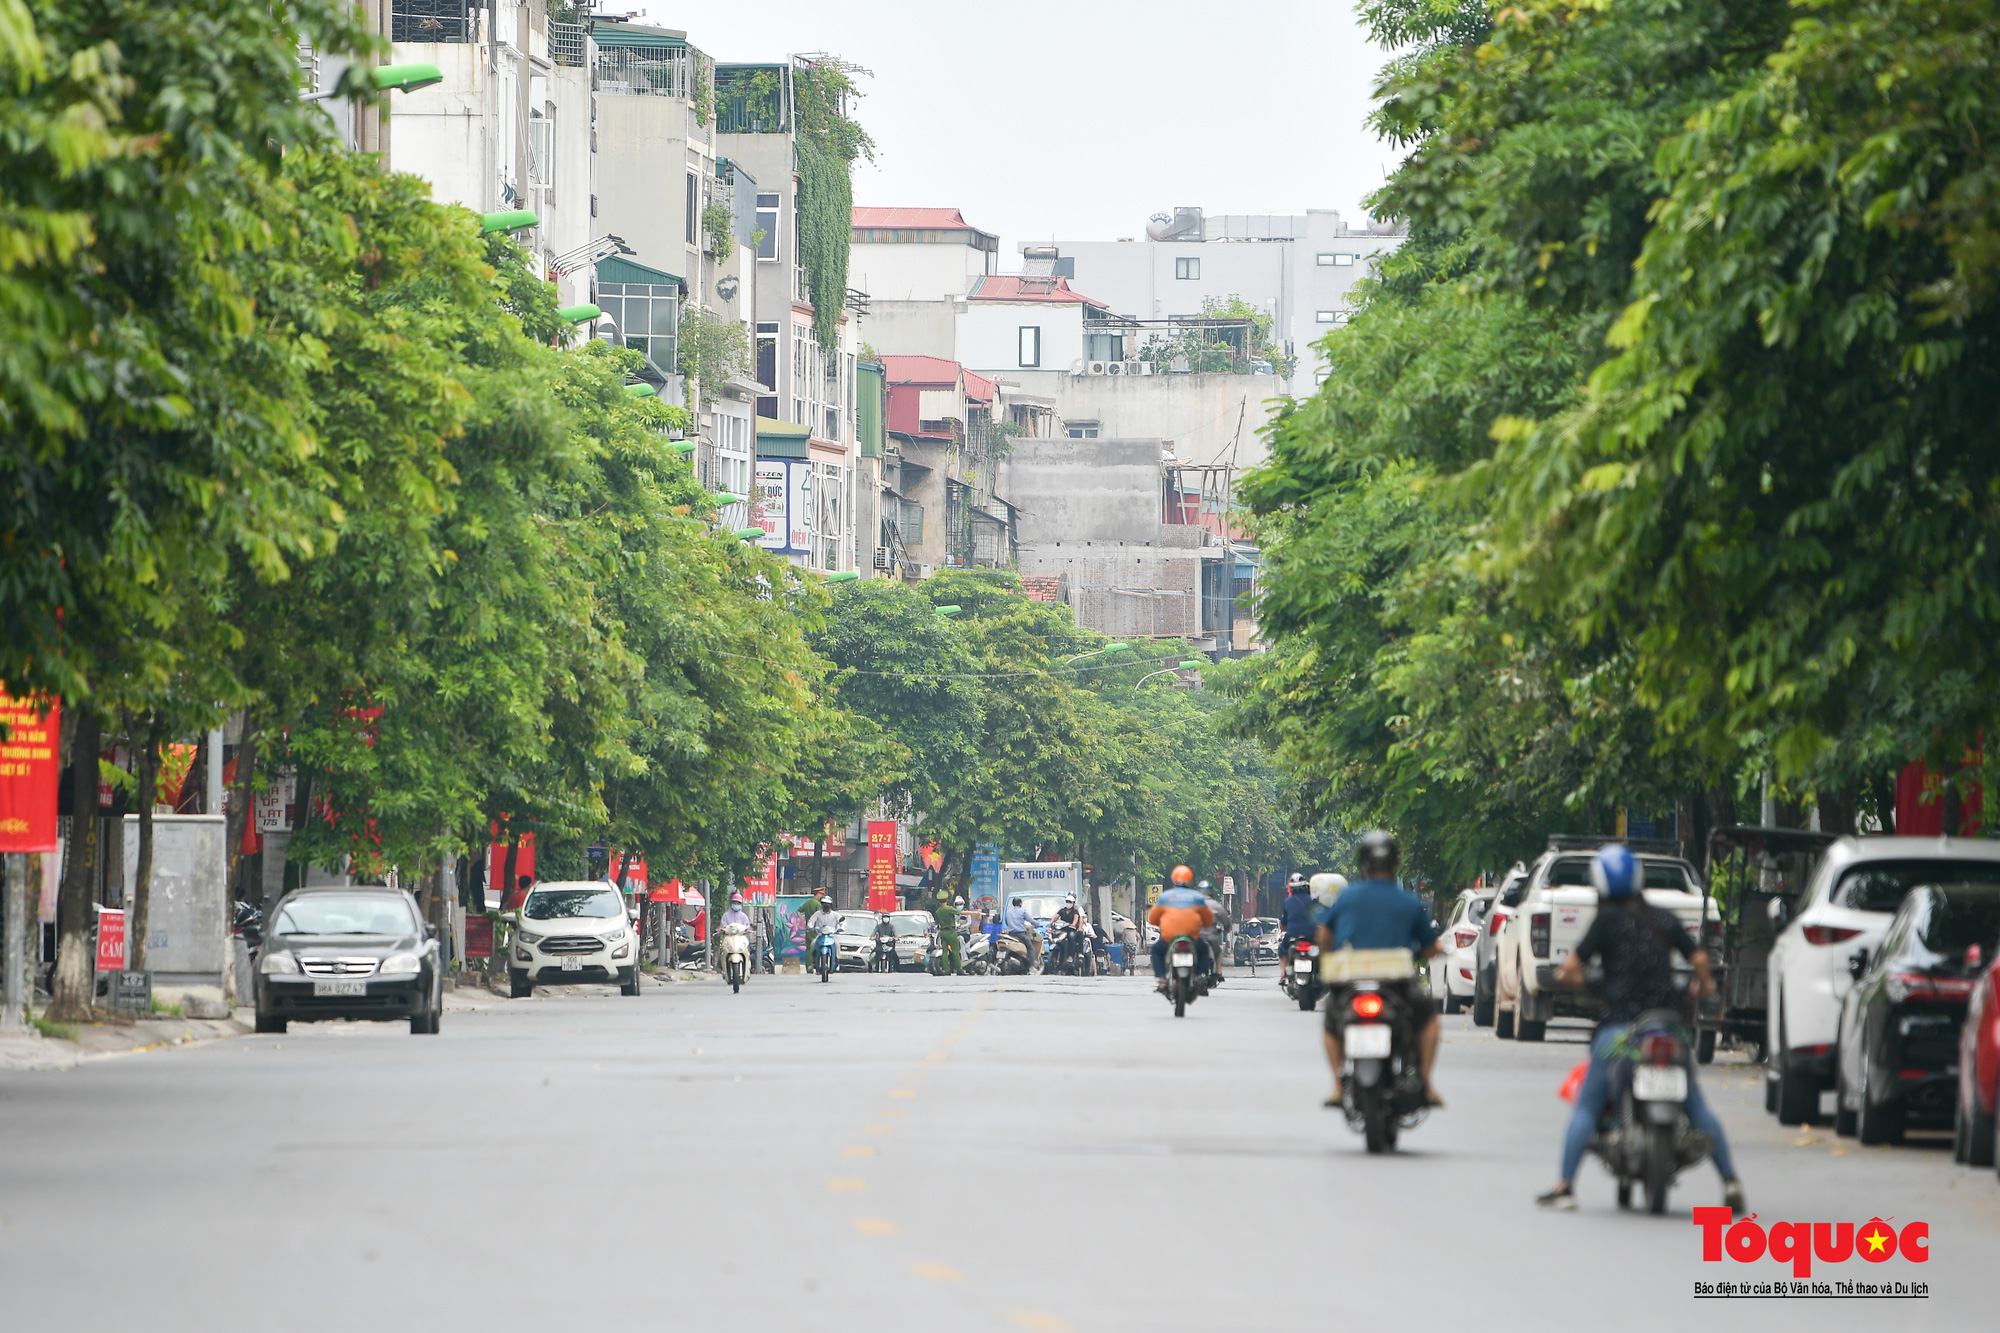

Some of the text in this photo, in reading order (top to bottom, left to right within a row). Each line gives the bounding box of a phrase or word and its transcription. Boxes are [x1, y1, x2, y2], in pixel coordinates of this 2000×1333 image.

[871, 833, 892, 843] 27-7
[1013, 868, 1066, 879] XE THƯ BÁO
[101, 936, 123, 958] CẤM
